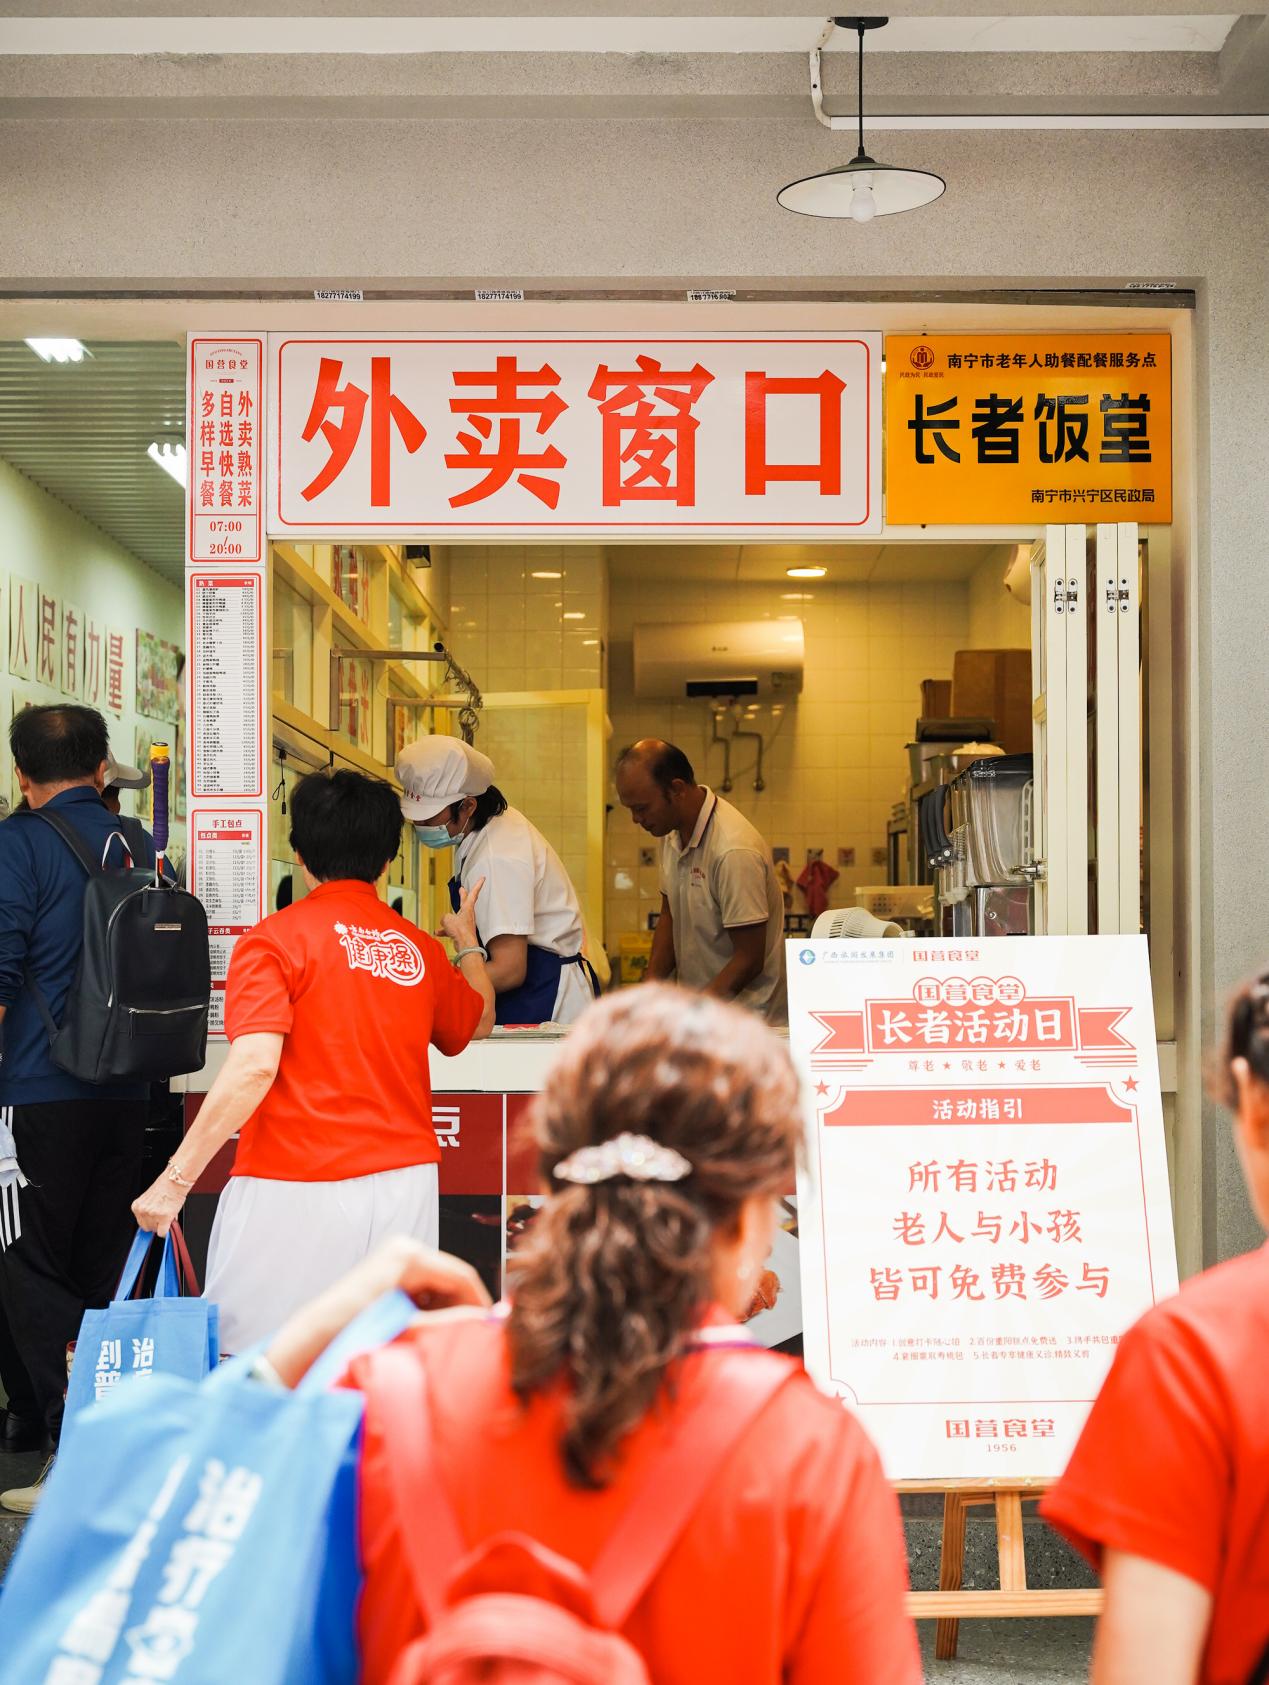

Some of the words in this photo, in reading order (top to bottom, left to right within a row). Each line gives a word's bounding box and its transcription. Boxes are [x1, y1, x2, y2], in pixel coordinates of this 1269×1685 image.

[205, 360, 248, 370] 国营食堂
[947, 352, 1157, 369] 南宁市老年人助餐配餐服务点
[300, 354, 847, 510] 外卖窗口
[908, 393, 1152, 464] 长者饭堂
[200, 390, 215, 507] 多样早餐
[219, 390, 234, 507] 自选快餐
[237, 390, 253, 507] 外卖熟菜
[1031, 488, 1155, 503] 南宁市兴宁区民政局
[209, 521, 242, 532] 07:00
[209, 544, 242, 554] 20:00
[13, 585, 124, 710] 人民有力量
[212, 819, 242, 828] 手工包点
[913, 950, 980, 962] 国营食堂
[917, 983, 1021, 1003] 国营食堂
[876, 1008, 1062, 1045] 长者活动日
[908, 1059, 935, 1072] 尊老
[961, 1059, 988, 1072] 敬老
[1014, 1058, 1041, 1071] 爱老
[932, 1097, 1024, 1120] 活动指引
[908, 1158, 1058, 1193] 所有活动
[892, 1209, 1083, 1246] 老人与小孩
[869, 1262, 1110, 1301] 皆可免费参与
[946, 1419, 1056, 1438] 国营食堂
[986, 1443, 1017, 1452] 1956
